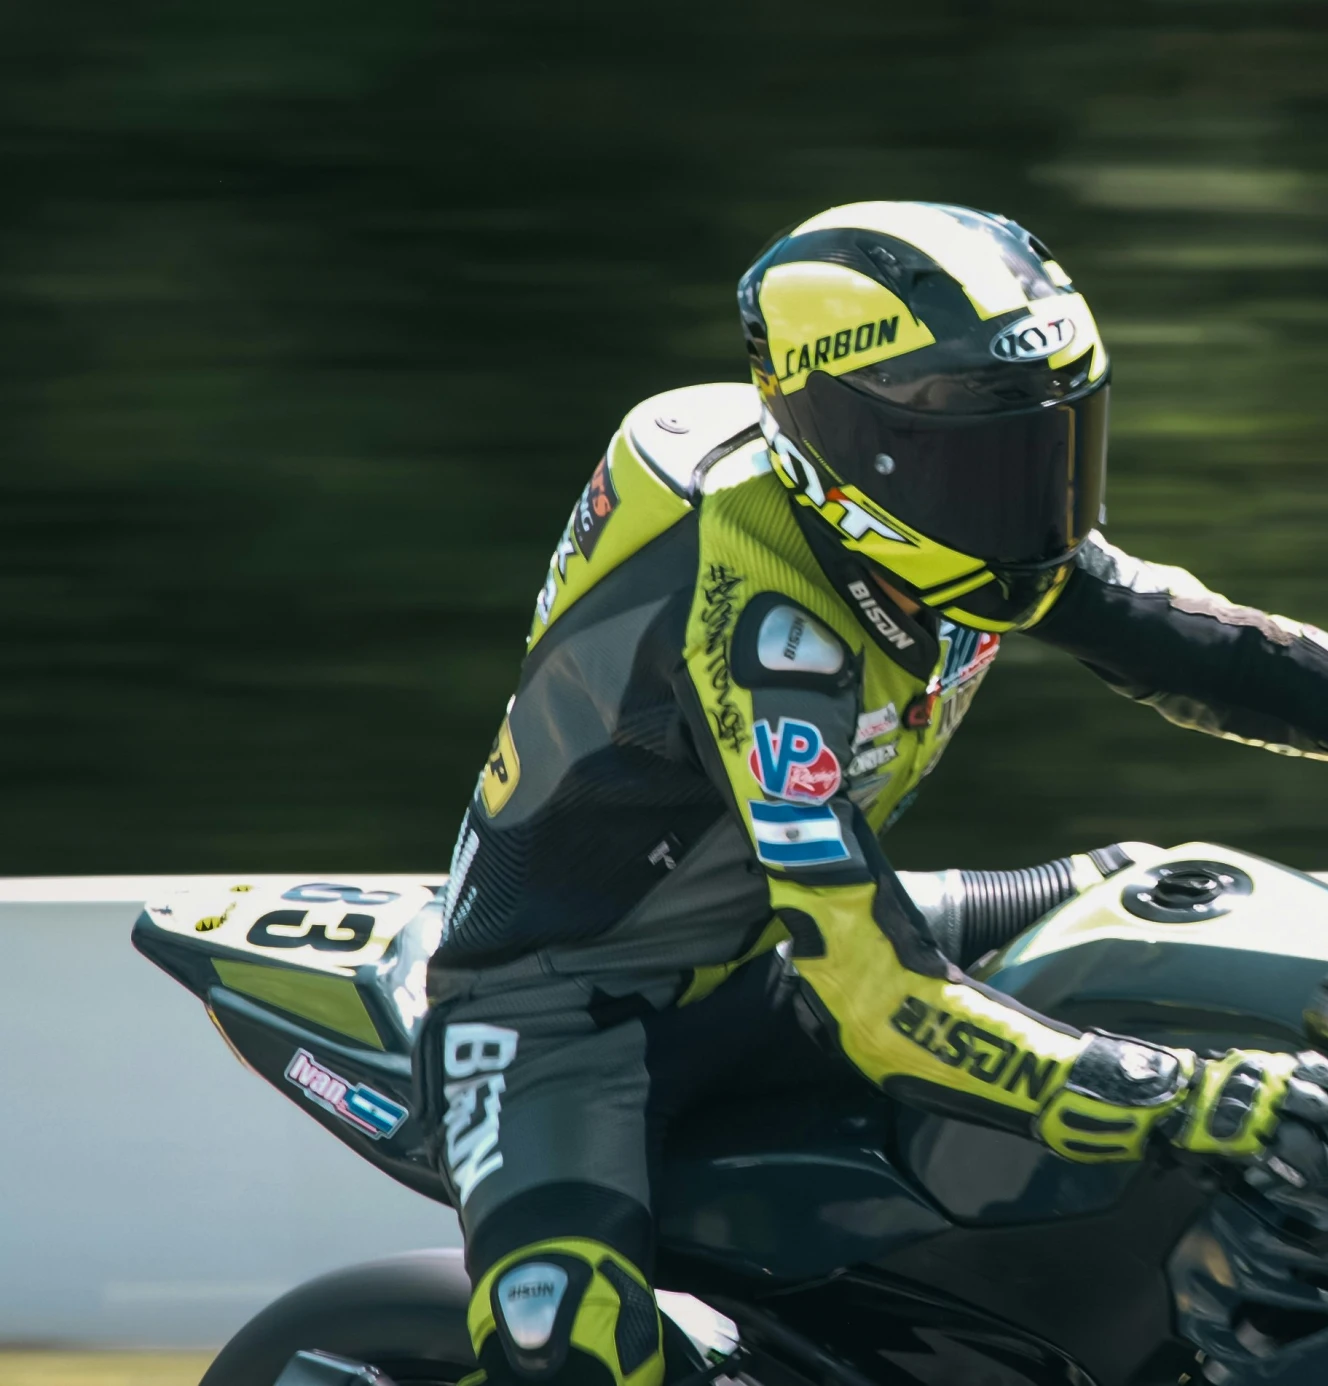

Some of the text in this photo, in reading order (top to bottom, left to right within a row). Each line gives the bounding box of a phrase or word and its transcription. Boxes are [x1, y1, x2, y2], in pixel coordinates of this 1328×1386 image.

[777, 316, 899, 381] CARBON
[1001, 316, 1066, 358] KYT
[782, 617, 806, 662] BISON
[848, 580, 916, 650] BISON
[753, 719, 820, 795] VP
[292, 1057, 346, 1105] Ivan
